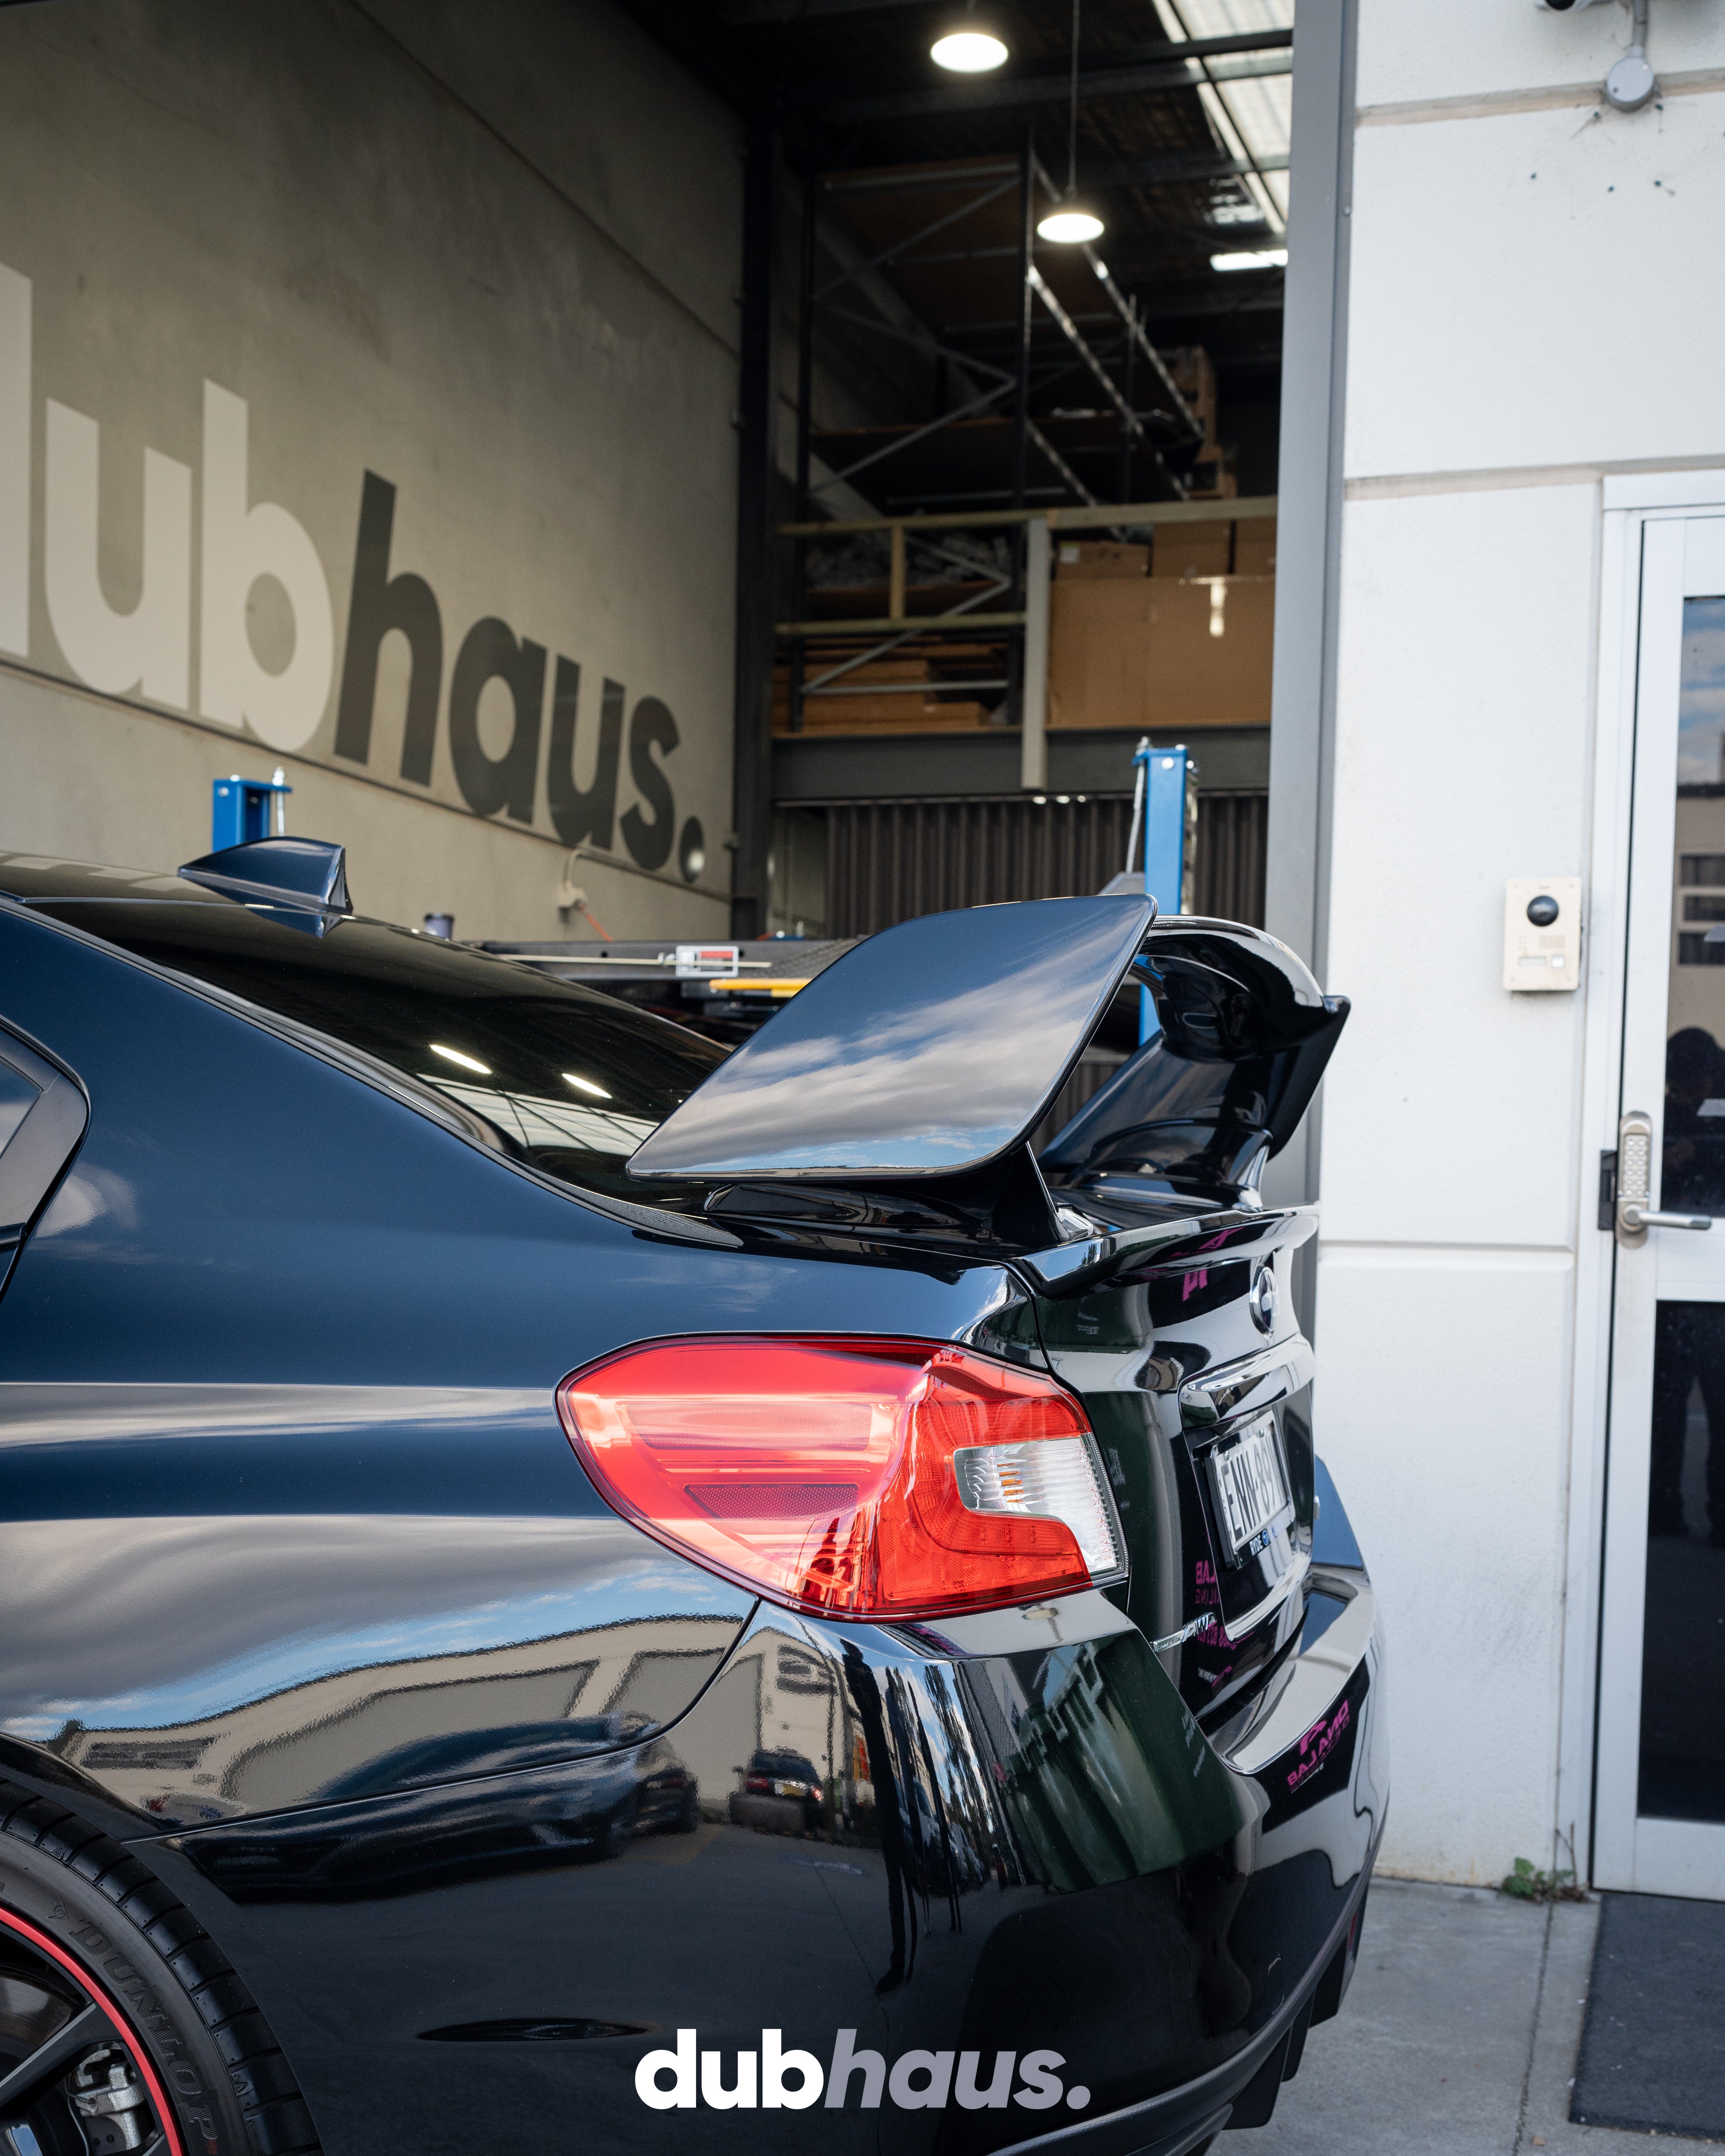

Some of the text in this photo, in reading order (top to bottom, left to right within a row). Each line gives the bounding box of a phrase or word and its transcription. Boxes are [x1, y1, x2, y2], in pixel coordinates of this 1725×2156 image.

[1249, 1534, 1263, 1556] RYDE
[1182, 1612, 1217, 1643] AWD
[68, 1922, 218, 2141] DUNLOP
